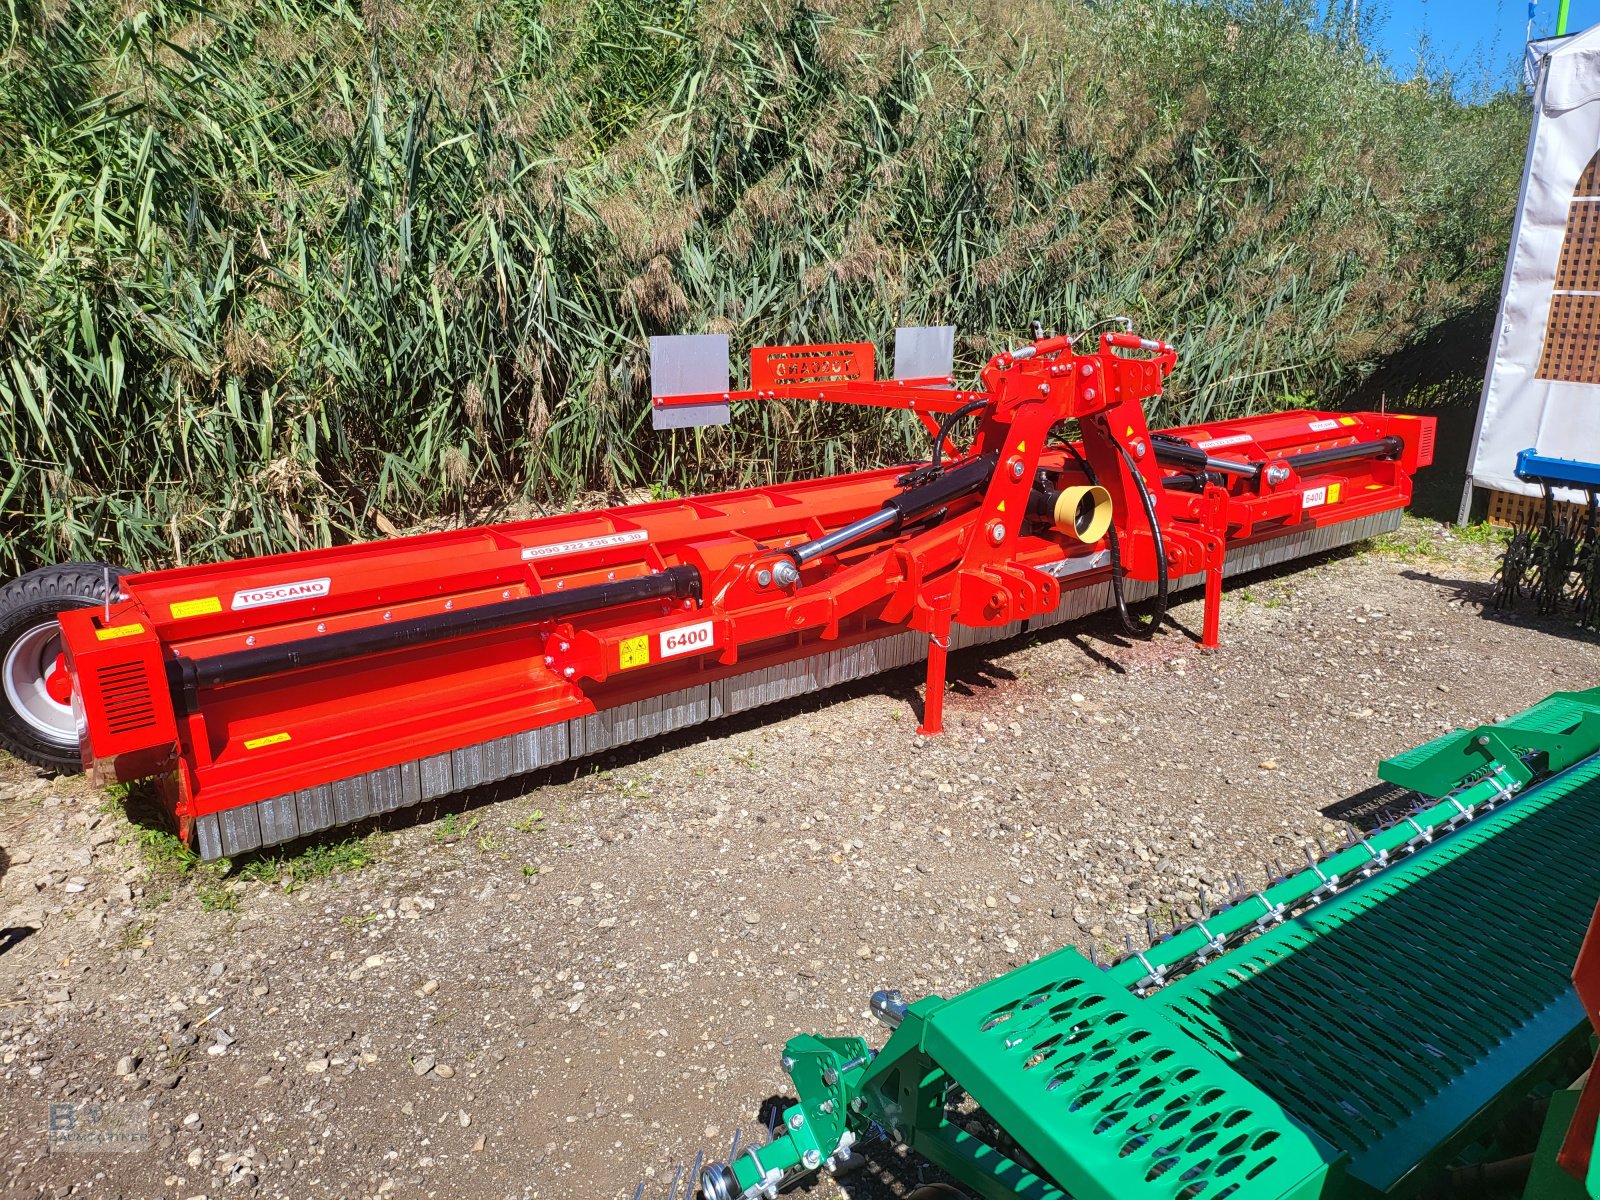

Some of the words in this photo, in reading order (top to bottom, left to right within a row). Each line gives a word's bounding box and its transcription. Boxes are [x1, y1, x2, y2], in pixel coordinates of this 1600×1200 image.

[1305, 491, 1323, 504] 6400
[530, 546, 560, 556] 0090
[563, 542, 585, 551] 222
[588, 537, 609, 547] 236
[611, 535, 625, 543] 16
[627, 533, 642, 541] 30
[240, 583, 324, 603] TOSCANO
[666, 628, 708, 650] 6400
